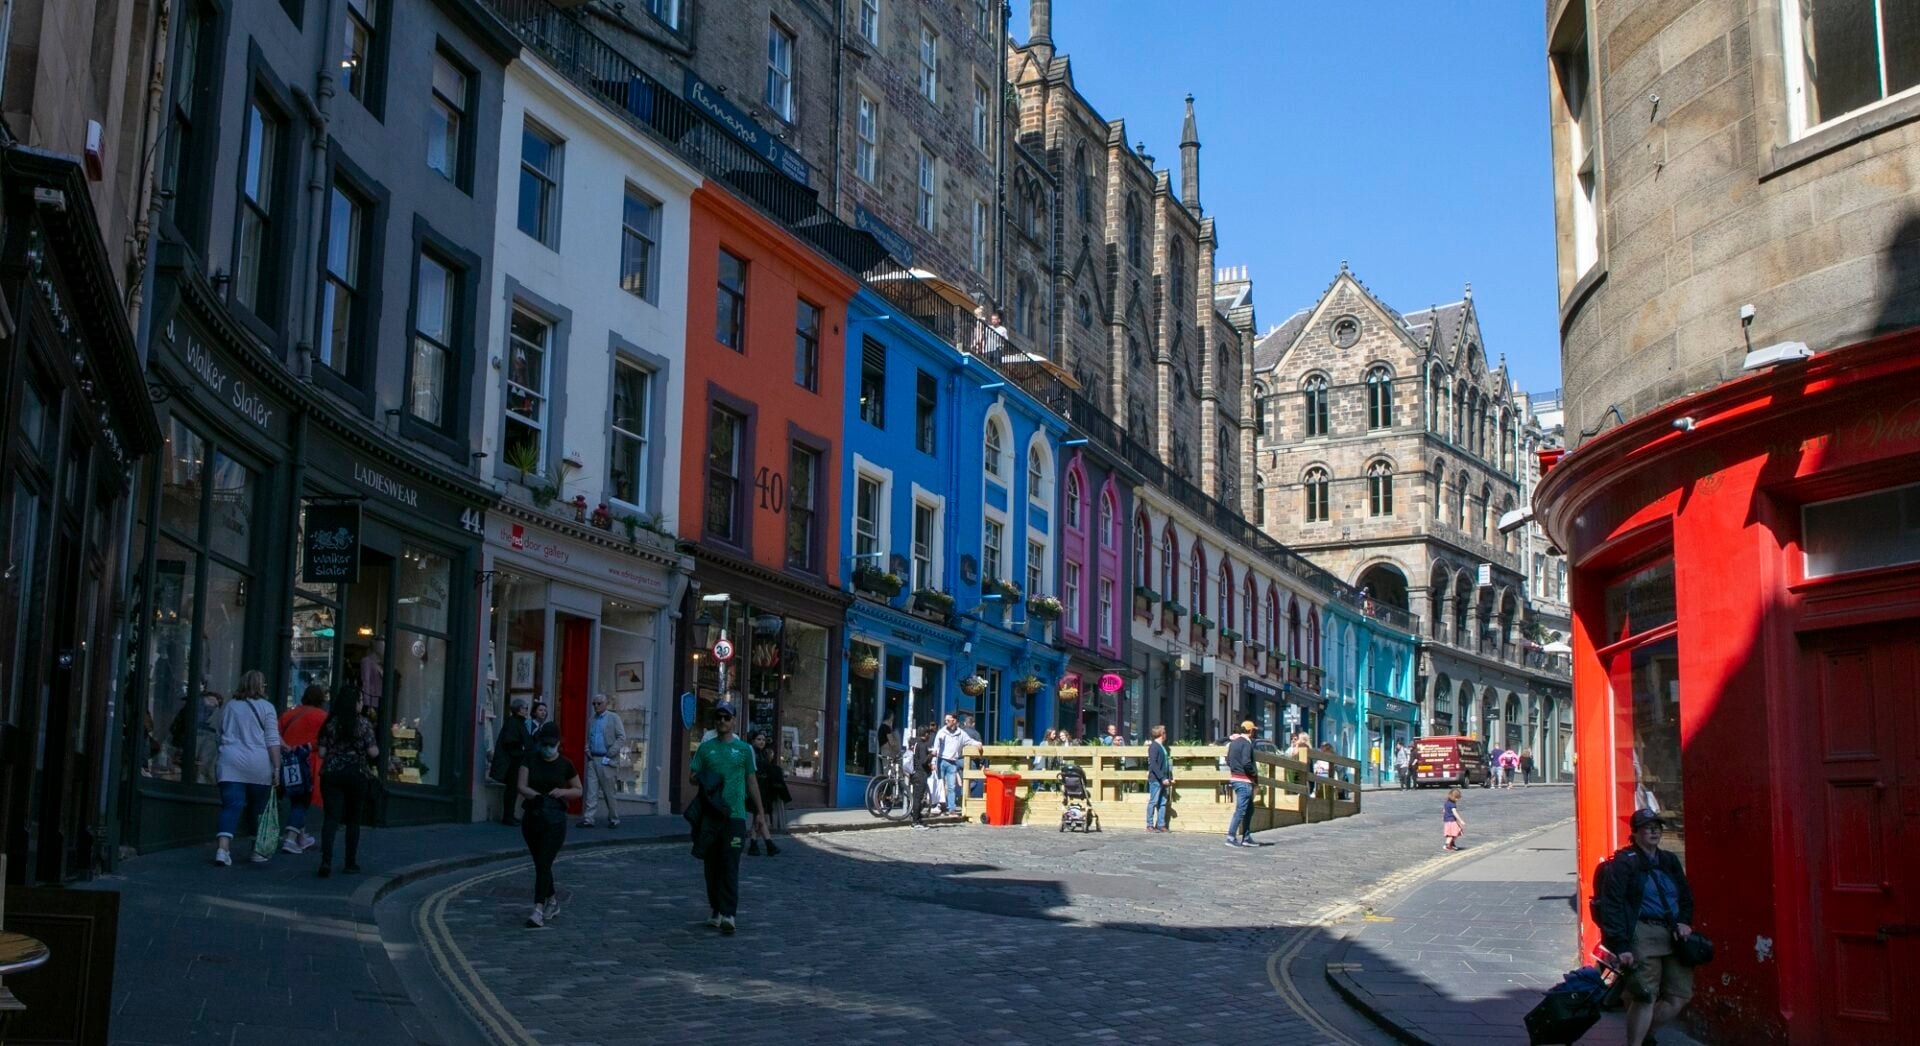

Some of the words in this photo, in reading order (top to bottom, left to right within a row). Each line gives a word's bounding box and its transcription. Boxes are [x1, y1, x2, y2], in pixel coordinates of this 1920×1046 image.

[187, 335, 227, 393] Walker
[232, 381, 273, 429] Slater
[354, 463, 418, 508] LADIESWEAR
[755, 466, 783, 514] 40
[313, 552, 352, 564] Walker
[523, 535, 541, 550] door
[544, 544, 570, 564] gallery
[314, 564, 348, 577] Slater
